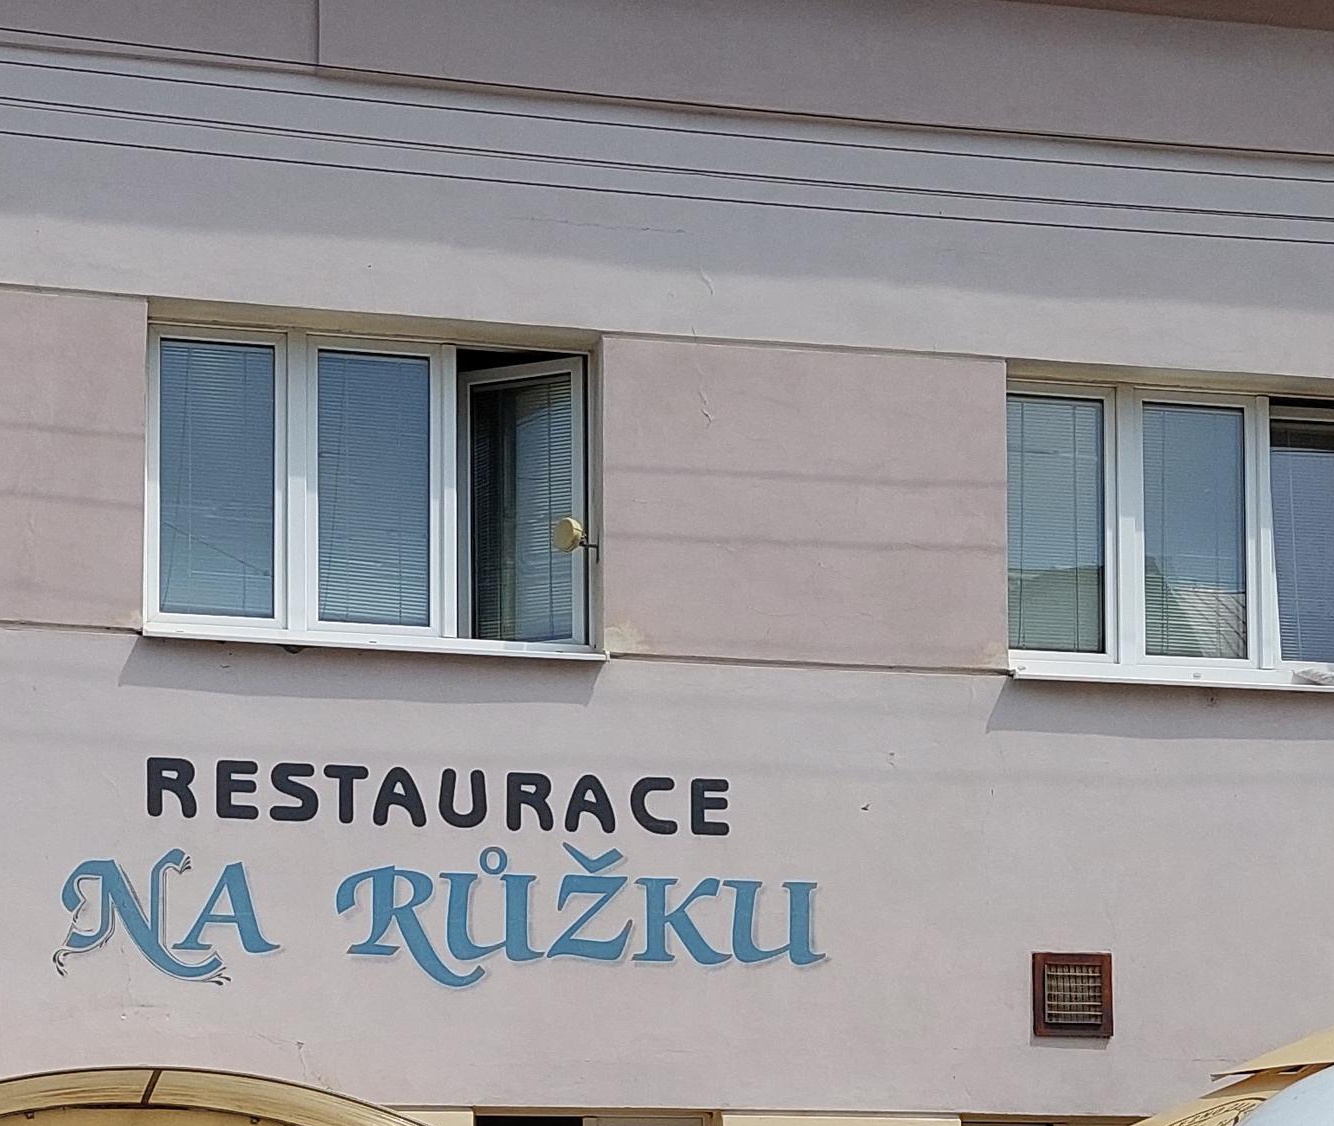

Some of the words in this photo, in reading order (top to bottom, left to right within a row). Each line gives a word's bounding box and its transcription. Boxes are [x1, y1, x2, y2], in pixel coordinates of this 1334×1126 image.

[145, 756, 731, 837] RESTAURACE
[51, 847, 283, 987] NA
[335, 841, 831, 990] RŮŽKU
